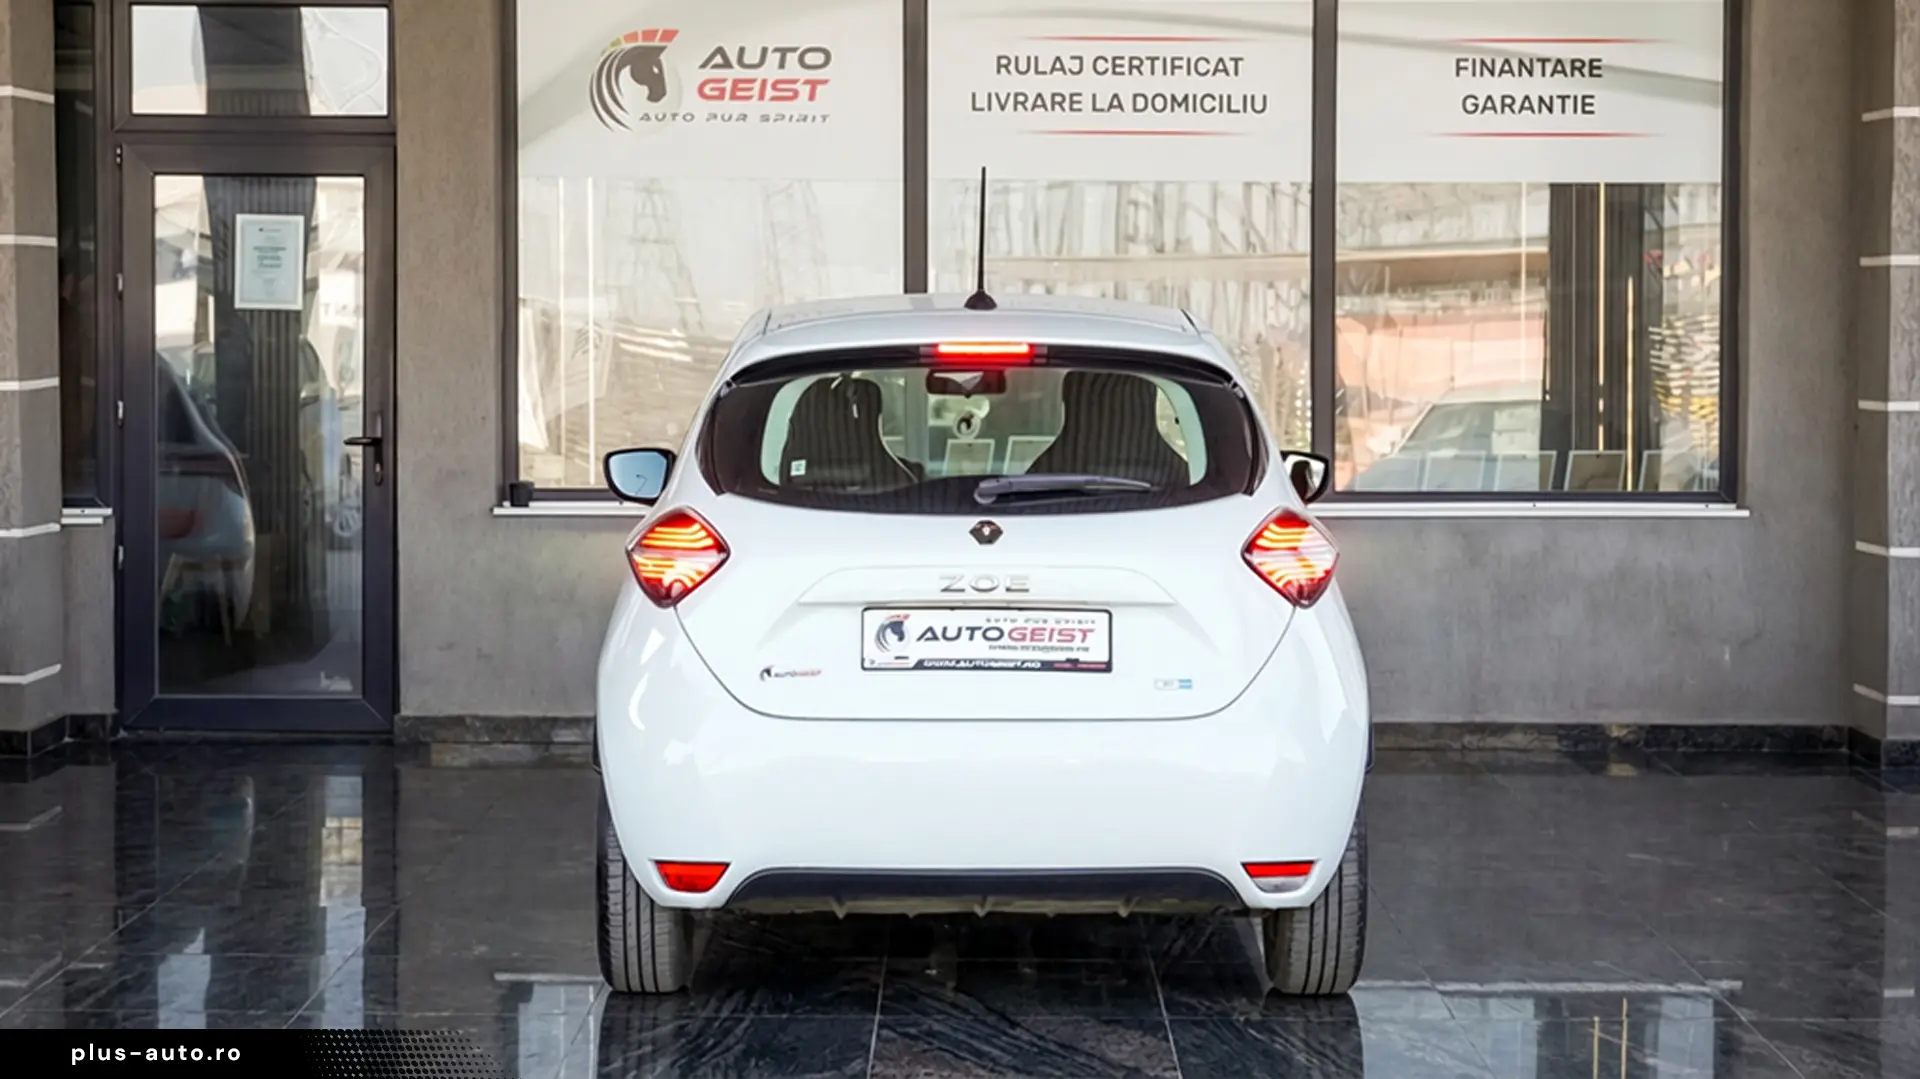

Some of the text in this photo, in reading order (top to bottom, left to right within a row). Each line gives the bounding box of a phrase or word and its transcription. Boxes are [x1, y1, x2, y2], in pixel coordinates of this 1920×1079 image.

[698, 45, 833, 71] AUTO
[996, 55, 1244, 77] RULAJ CERTIFICAT
[1455, 57, 1604, 78] FINANTARE
[696, 78, 831, 102] GEIST
[971, 92, 1268, 114] LIVRARE LA DOMICILIU
[1461, 94, 1596, 115] GARANTIE
[639, 112, 831, 124] AUTO PUR SPIRIT
[939, 574, 1030, 593] ZOE
